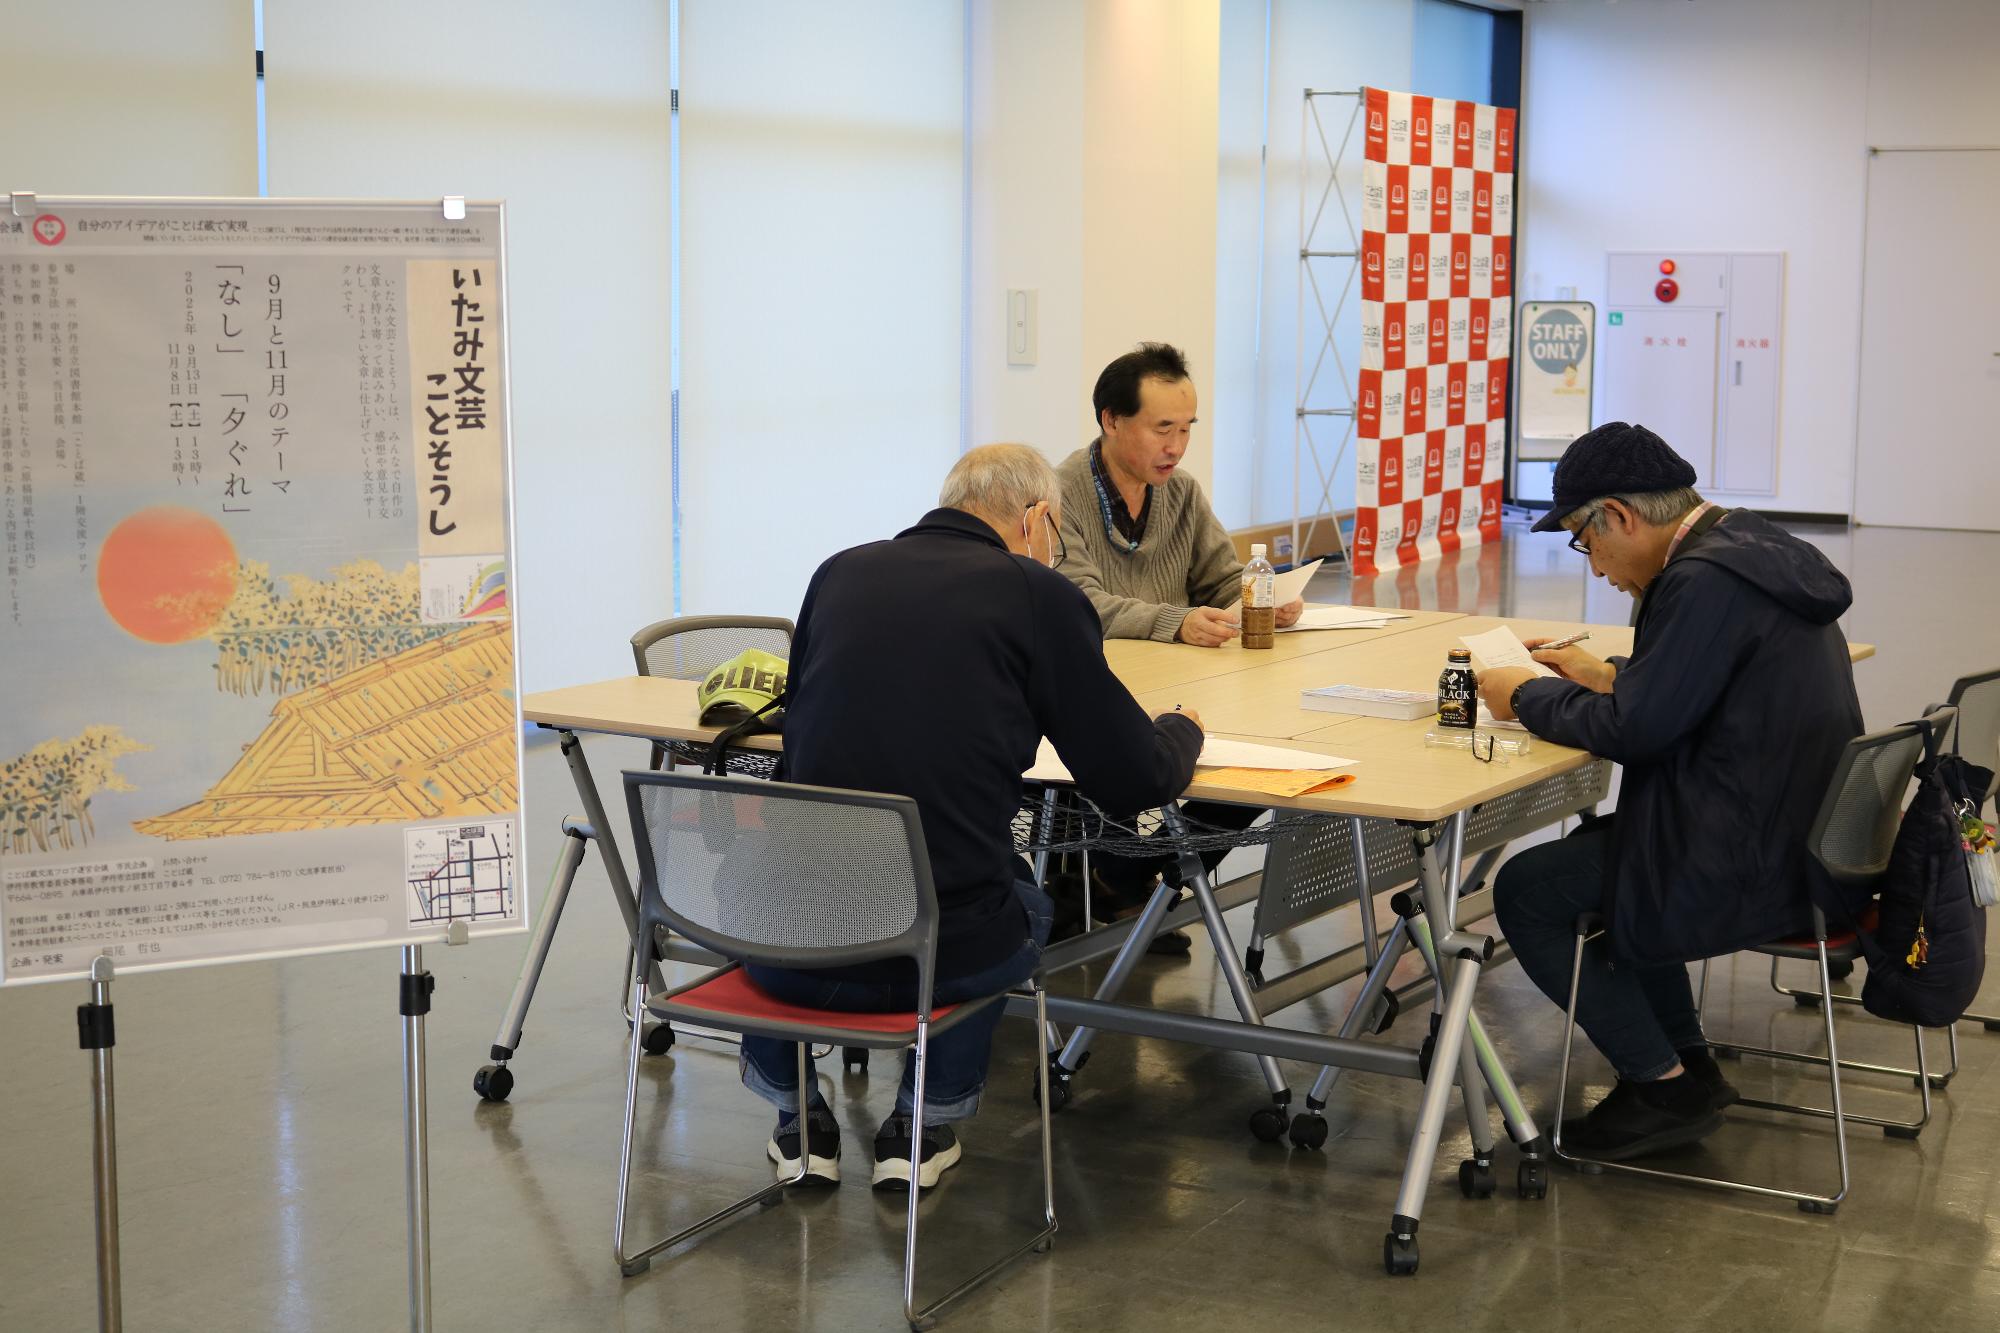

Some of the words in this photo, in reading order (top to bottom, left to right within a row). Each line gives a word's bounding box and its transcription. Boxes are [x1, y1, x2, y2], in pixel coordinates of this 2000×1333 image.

[77, 219, 248, 233] 自分のアイデアがことば蔵で実現
[184, 271, 197, 336] 2025年
[451, 269, 486, 430] いたみ文芸
[1532, 323, 1584, 341] STAFF
[1533, 343, 1581, 360] ONLY
[264, 273, 291, 494] 9月と11月のテーマ
[425, 374, 457, 536] ことそうし
[1439, 688, 1470, 700] BLACK
